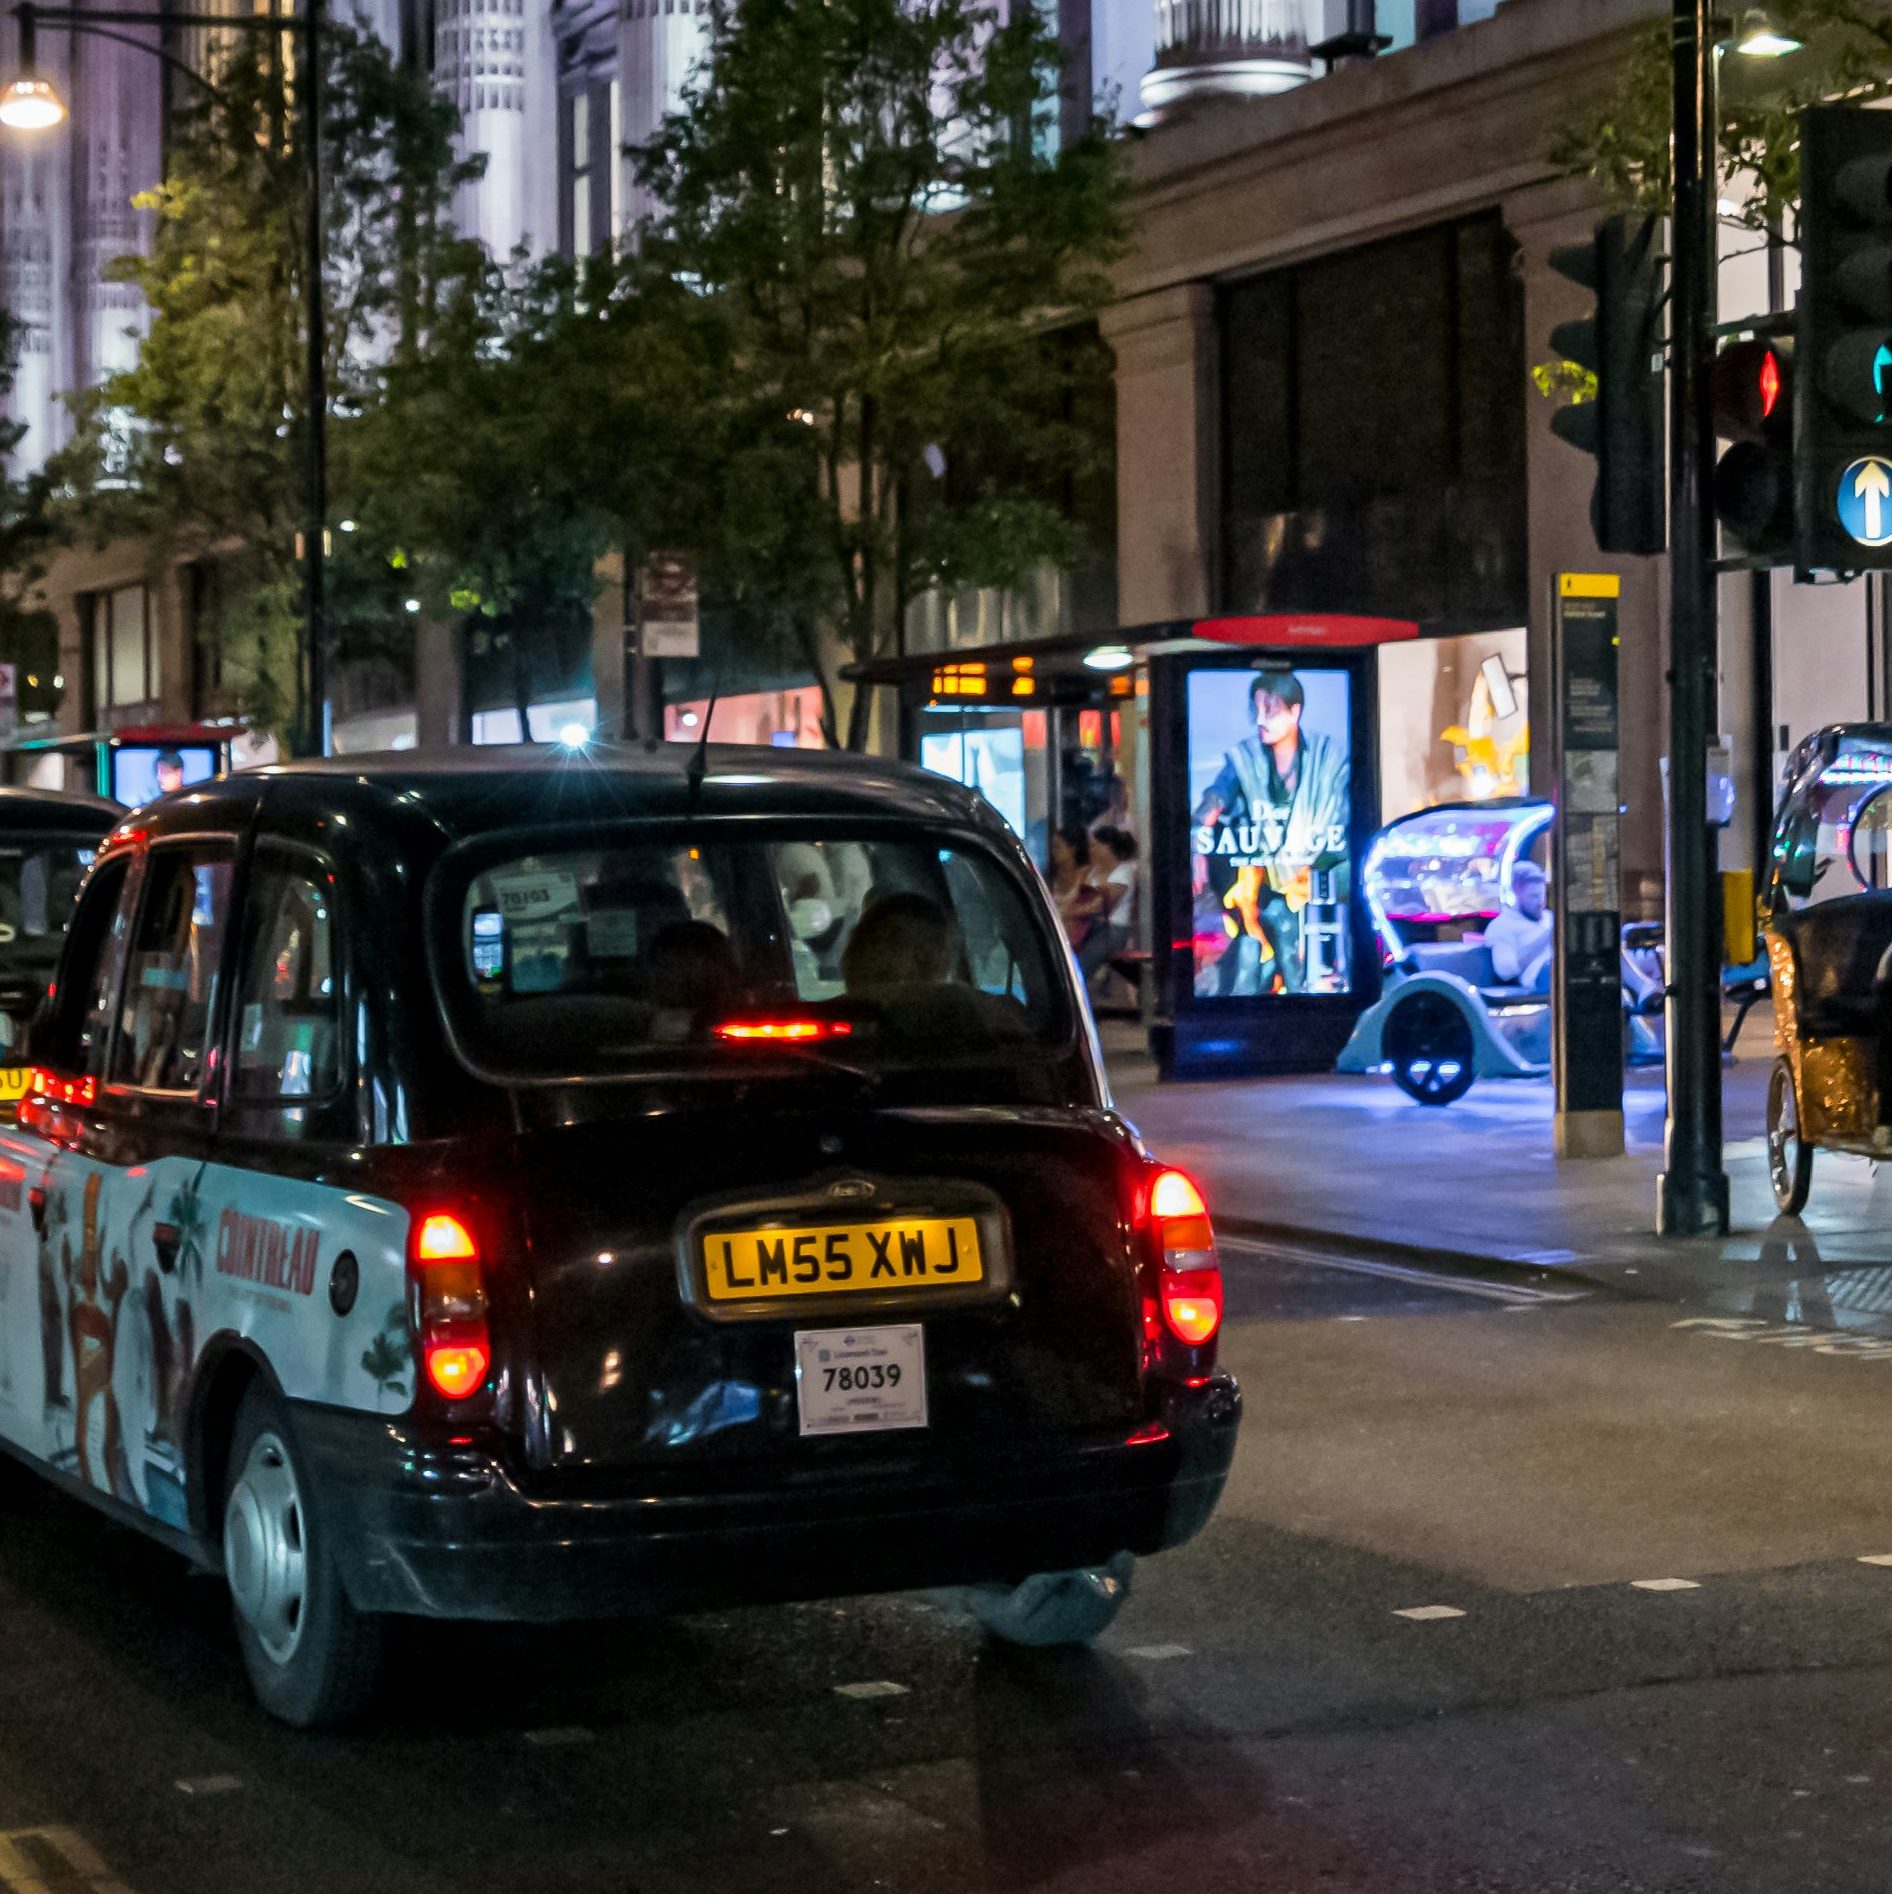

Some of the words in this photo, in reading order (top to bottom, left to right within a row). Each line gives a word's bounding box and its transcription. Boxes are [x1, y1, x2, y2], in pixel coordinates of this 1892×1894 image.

[722, 1232, 853, 1289] LM55
[865, 1227, 960, 1279] XWJ
[822, 1363, 902, 1393] 78039
